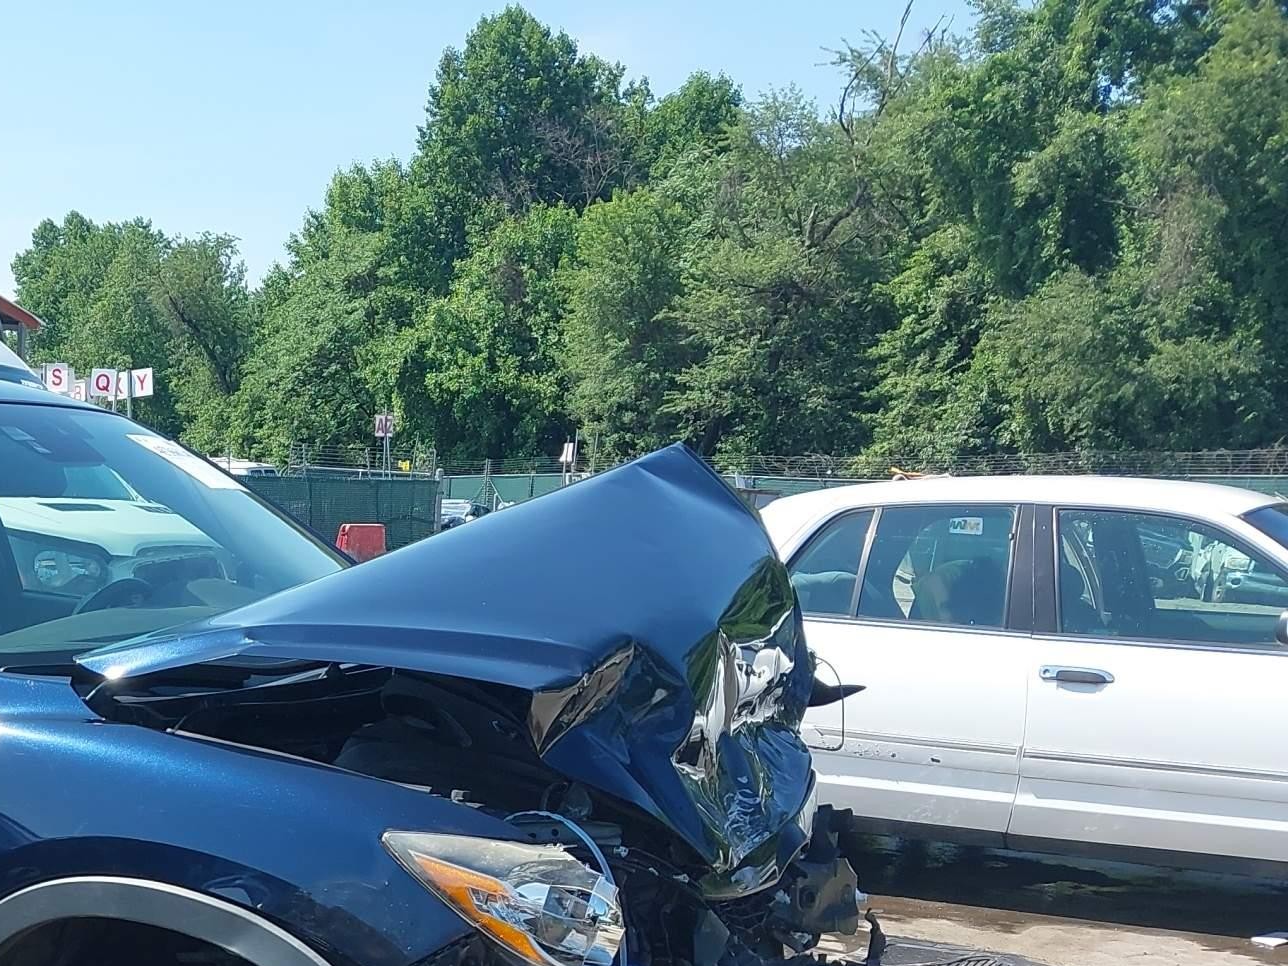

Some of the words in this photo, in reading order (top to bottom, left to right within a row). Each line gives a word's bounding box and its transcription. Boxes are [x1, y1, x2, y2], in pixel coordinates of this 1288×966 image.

[52, 368, 62, 386] S
[95, 373, 109, 392] Q
[137, 374, 147, 391] Y
